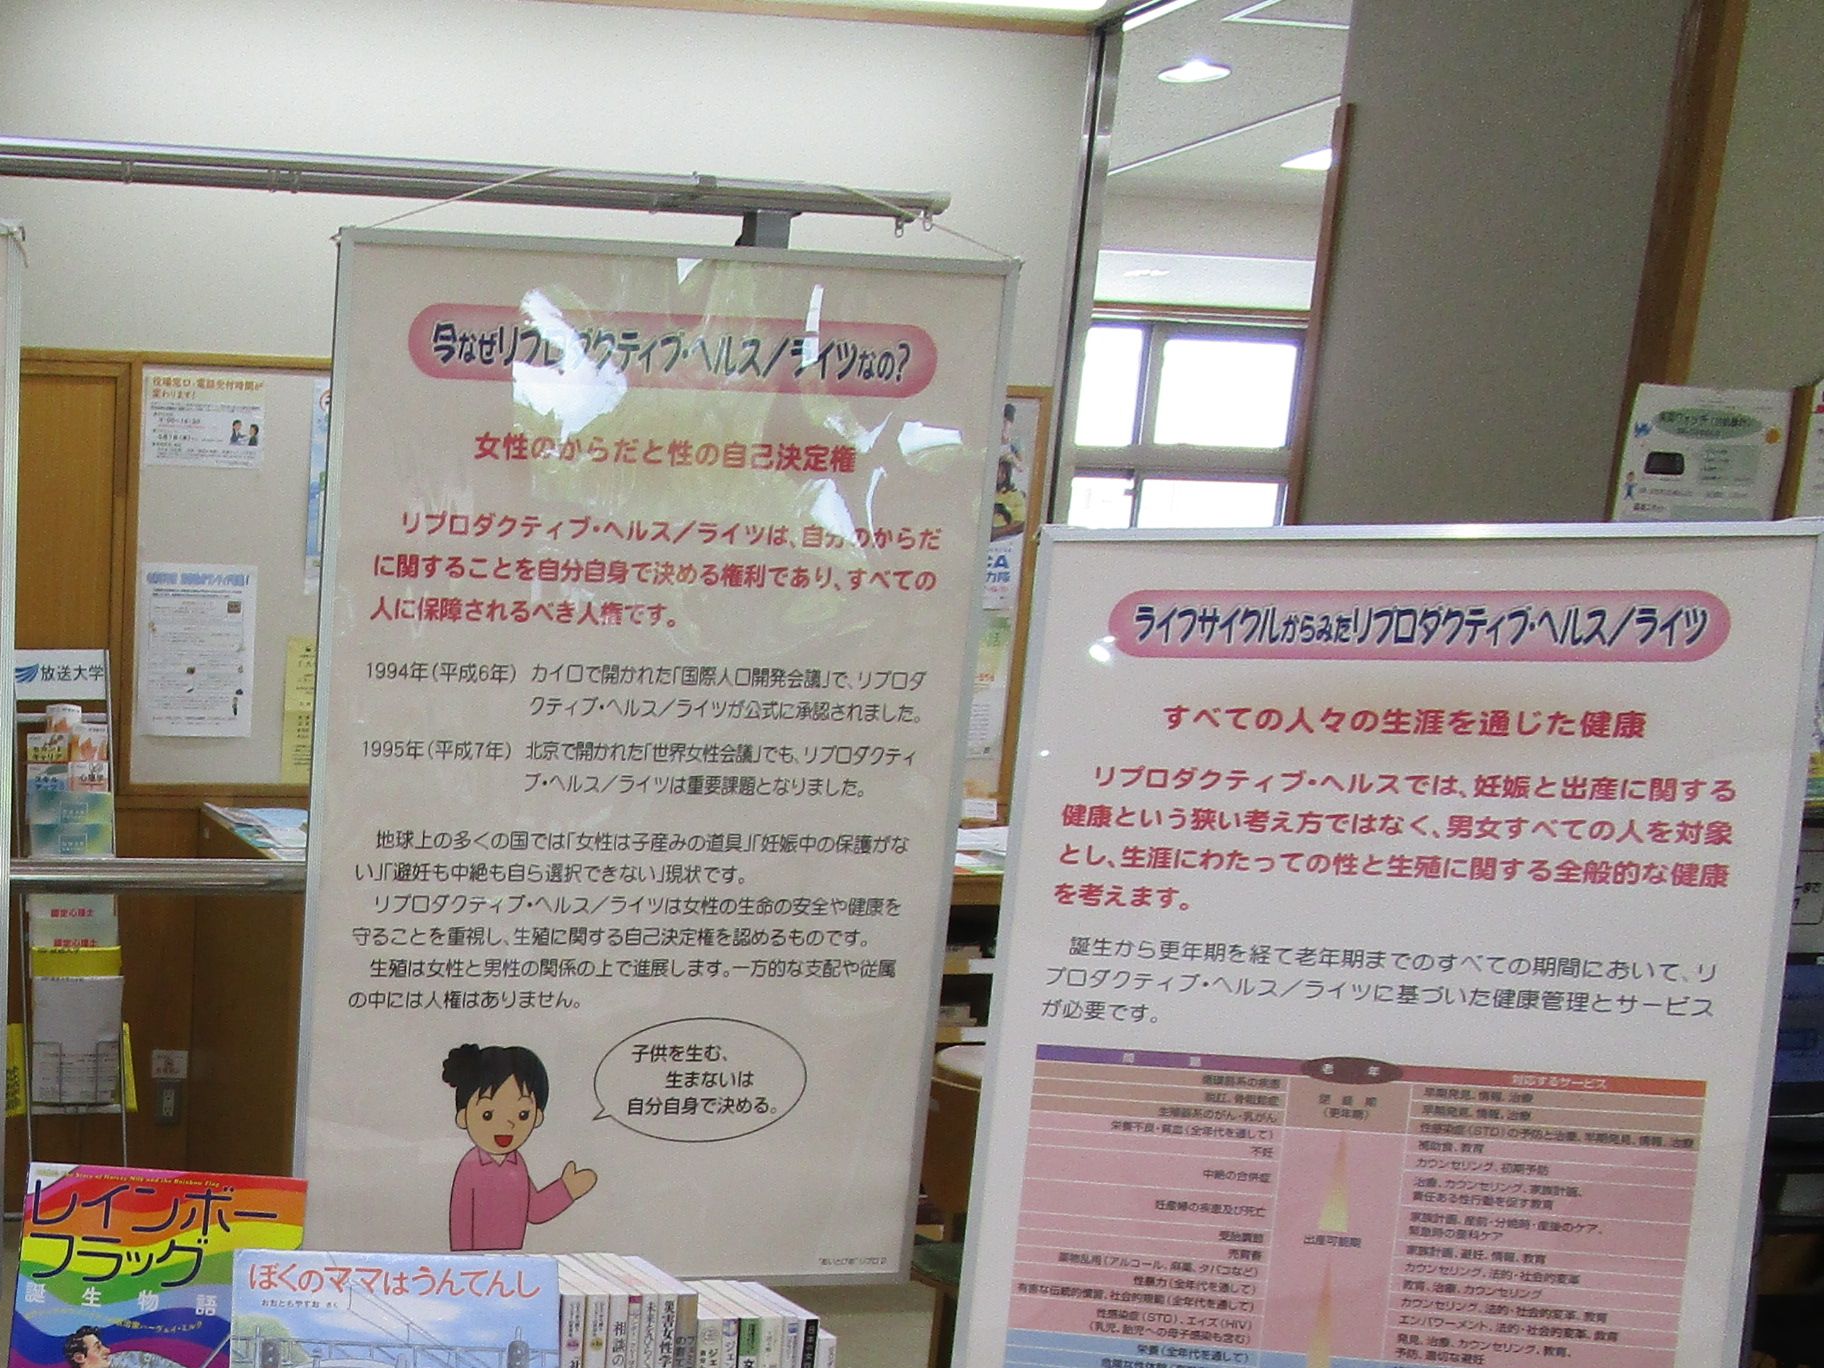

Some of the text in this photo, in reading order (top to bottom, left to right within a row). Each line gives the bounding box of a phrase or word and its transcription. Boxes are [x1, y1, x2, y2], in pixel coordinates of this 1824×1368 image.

[474, 431, 857, 475] 女性のからだと性の自己決定権
[373, 554, 937, 593] に関することを自分自身で決める権利であり、すべての
[371, 596, 678, 629] 人に保障されるべき人権です。
[40, 664, 105, 681] 放送大学
[1164, 705, 1647, 739] すべての人々の生涯を通じた健康
[1094, 766, 1737, 803] リプロダクティブ・ヘルスでは、妊娠と出産に関する
[1062, 804, 1732, 846] 健康という狭い考え方ではなく、男女すべての人を対象
[1059, 845, 1729, 889] とし、生涯にわたっての性と生殖に関する全般的な健康
[1054, 884, 1193, 912] を考えます。
[1069, 937, 1717, 982] 誕生から更年期を経て老年期までのすべての期間において、リ
[347, 988, 584, 1011] の中には人権はありません。
[1041, 1000, 1159, 1025] が必要です。
[630, 1044, 729, 1064] 子供を生む、
[664, 1070, 755, 1090] 生まないは
[627, 1097, 778, 1117] 自分自身で決める。
[32, 1178, 278, 1237] レインボー
[29, 1233, 210, 1288] フラッグ
[248, 1261, 542, 1299] ぼくのママはうんてんし
[25, 1281, 218, 1317] 誕生物語
